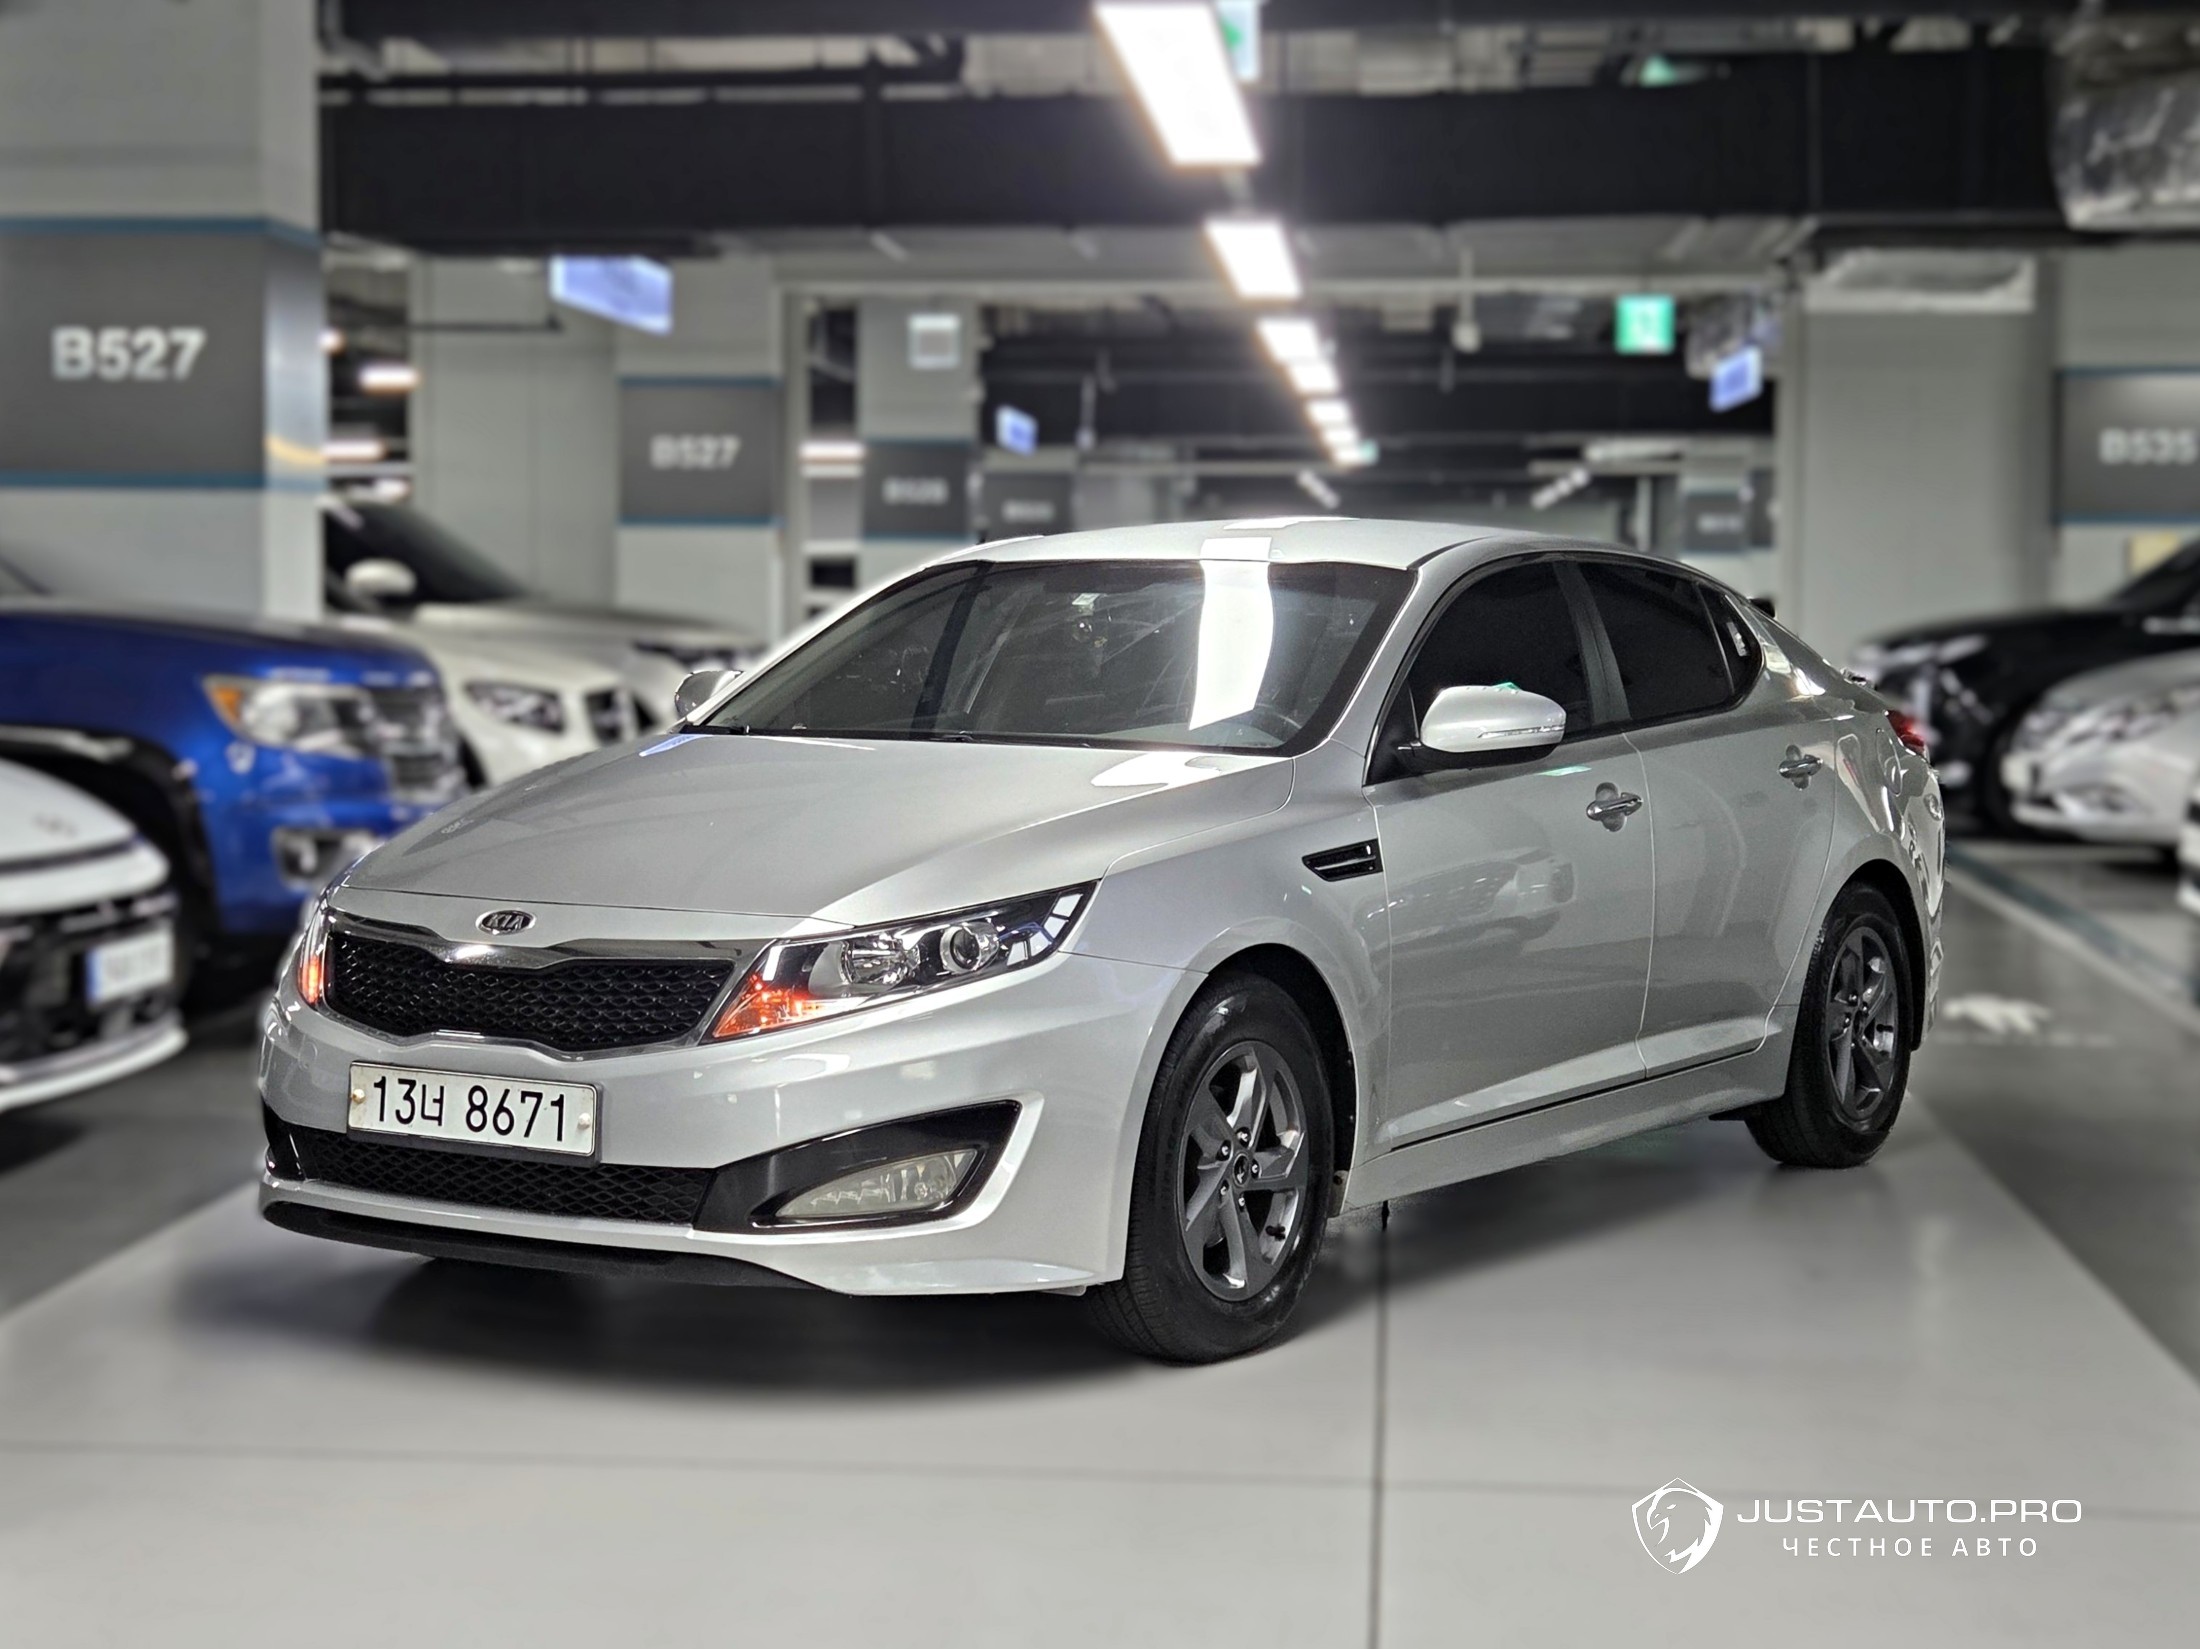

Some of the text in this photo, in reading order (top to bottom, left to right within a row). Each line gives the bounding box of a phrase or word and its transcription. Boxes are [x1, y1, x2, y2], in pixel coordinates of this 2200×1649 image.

[53, 327, 205, 380] B527
[651, 436, 741, 469] B527
[486, 913, 525, 930] KIA
[373, 1076, 566, 1142] 13너 8671
